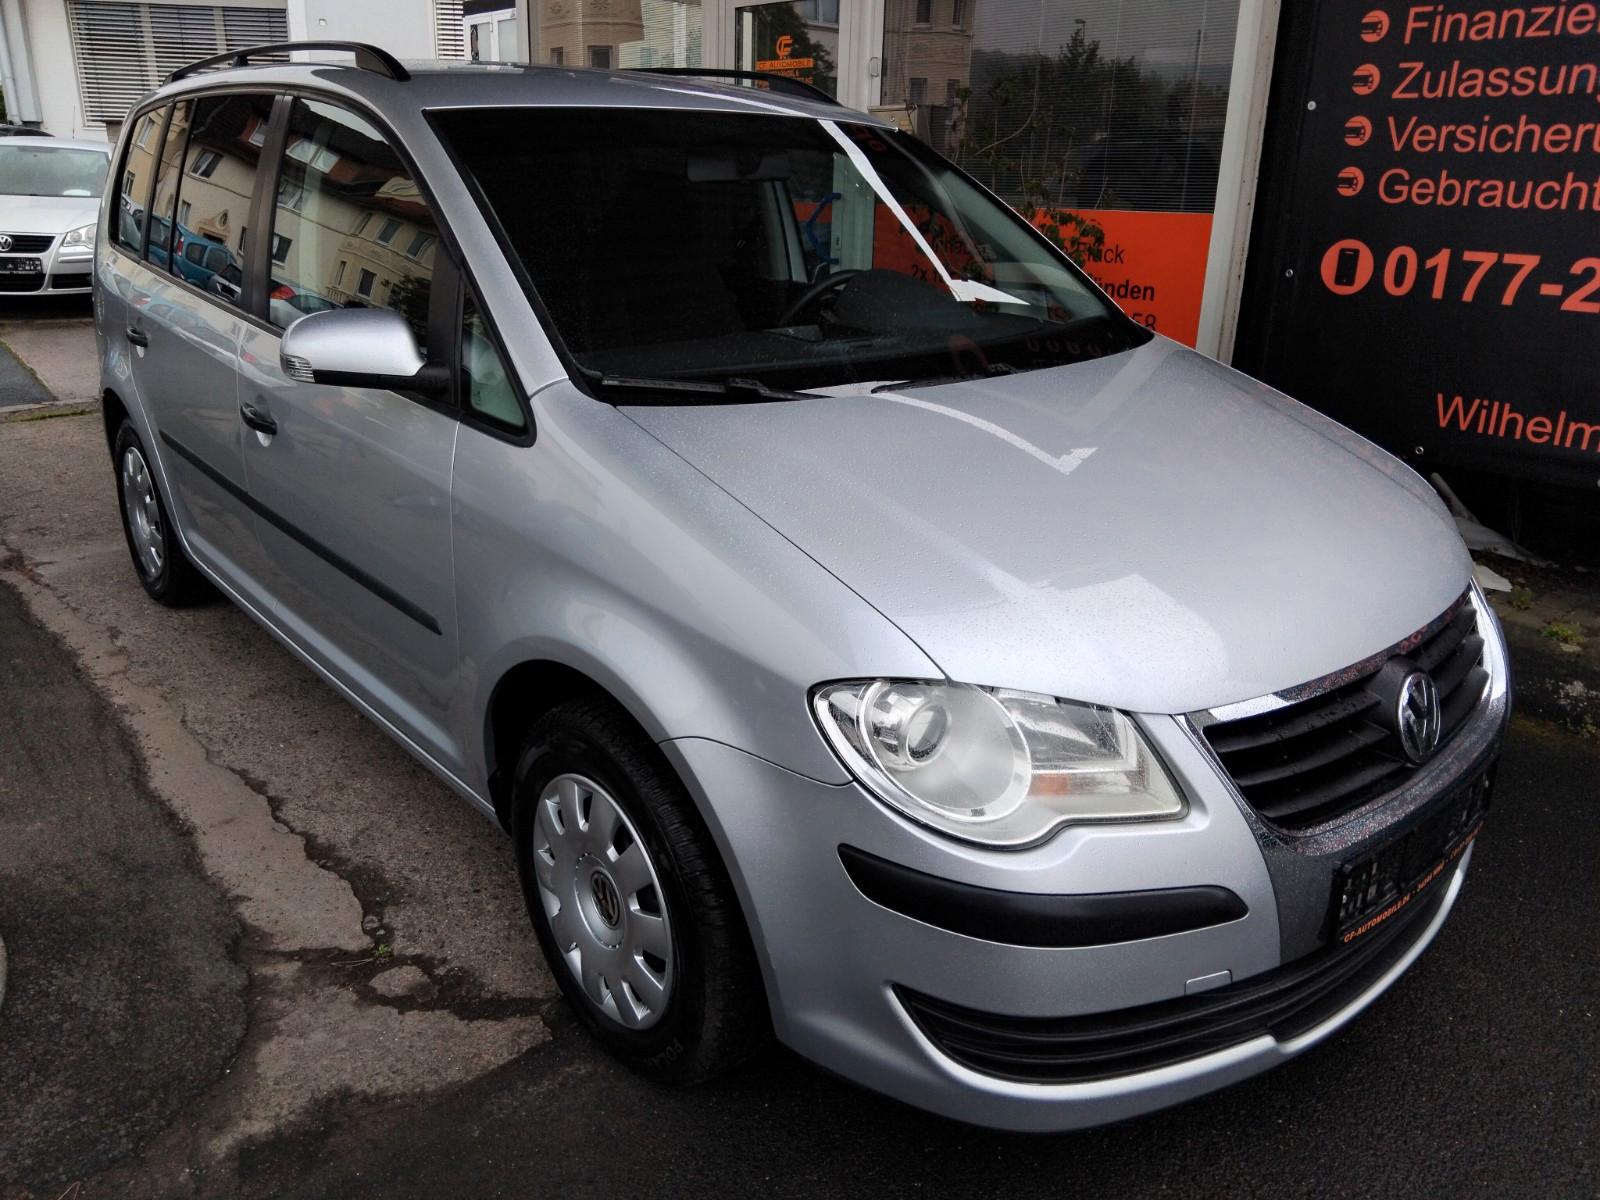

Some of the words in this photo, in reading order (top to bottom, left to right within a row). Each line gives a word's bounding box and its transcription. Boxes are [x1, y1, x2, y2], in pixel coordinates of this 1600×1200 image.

[1404, 0, 1600, 44] Finanzie
[1391, 60, 1600, 104] Zulassun
[1383, 246, 1600, 313] 0177-2
[1437, 392, 1600, 453] Wilhelm
